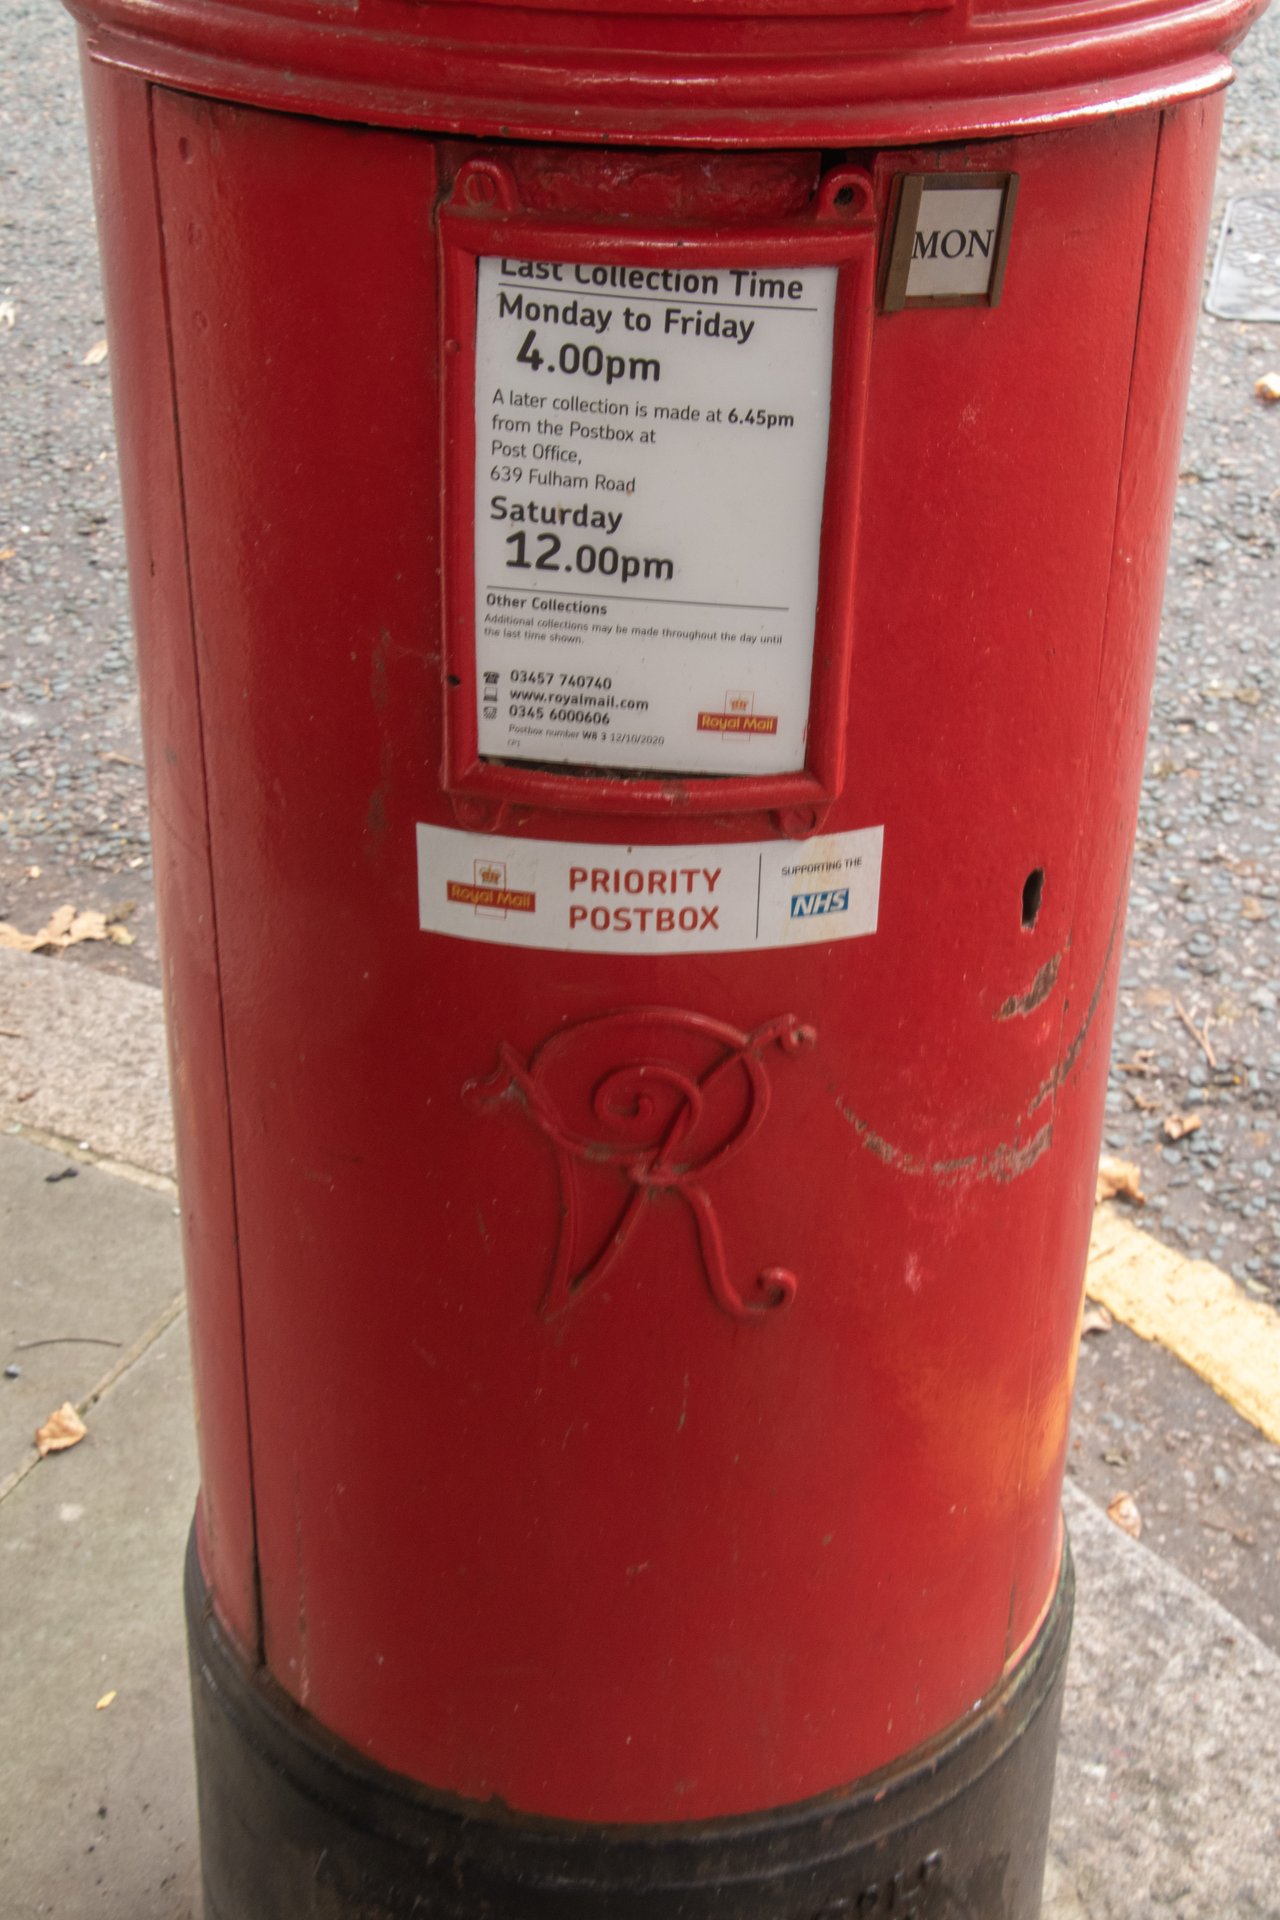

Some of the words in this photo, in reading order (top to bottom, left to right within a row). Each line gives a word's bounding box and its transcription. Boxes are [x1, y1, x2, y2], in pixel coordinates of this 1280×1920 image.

[912, 229, 994, 259] MON
[501, 259, 562, 281] Last
[574, 263, 718, 295] Collection
[730, 269, 803, 300] Time
[498, 292, 612, 333] Monday
[623, 307, 651, 331] to
[664, 308, 755, 344] Friday
[516, 329, 661, 384] 4.00pm
[492, 388, 505, 405] A
[509, 390, 548, 409] later
[552, 395, 629, 416] collection
[635, 401, 648, 418] is
[654, 402, 701, 421] made
[706, 407, 723, 423] at
[727, 407, 795, 428] 6.45pm
[492, 414, 531, 434] from
[537, 419, 564, 436] the
[569, 421, 635, 443] Postbox
[640, 428, 656, 444] at
[491, 440, 527, 459] Post
[532, 443, 582, 466] Office,
[490, 465, 523, 484] 639
[528, 468, 589, 490] Fulham
[595, 475, 636, 493] Road
[490, 495, 624, 534] Saturday
[505, 530, 675, 583] 12.00pm
[486, 592, 527, 608] Other
[531, 596, 608, 616] Collections
[484, 613, 534, 627] Additional
[537, 618, 589, 632] collections
[591, 624, 613, 635] may
[615, 625, 628, 635] be
[631, 626, 659, 637] made
[662, 628, 717, 641] throughout
[720, 632, 736, 642] the
[739, 632, 757, 644] day
[760, 634, 783, 645] until
[484, 627, 500, 637] the
[503, 628, 521, 639] last
[524, 629, 546, 640] time
[549, 633, 584, 645] shown.
[510, 669, 554, 686] 03457
[560, 673, 612, 690] 740740
[509, 688, 649, 711] www.royalmail.com
[509, 704, 544, 720] 0345
[549, 708, 610, 725] 6000606
[702, 714, 740, 730] Royal
[743, 717, 774, 731] Mail
[508, 723, 543, 736] Postbox
[545, 728, 579, 739] number
[781, 860, 842, 876] SUPPORTING
[844, 856, 863, 868] THE
[569, 866, 721, 895] PRIORITY
[451, 884, 494, 904] Royal
[498, 892, 530, 908] Mail
[793, 890, 846, 916] NHS
[569, 905, 719, 933] POSTBOX
